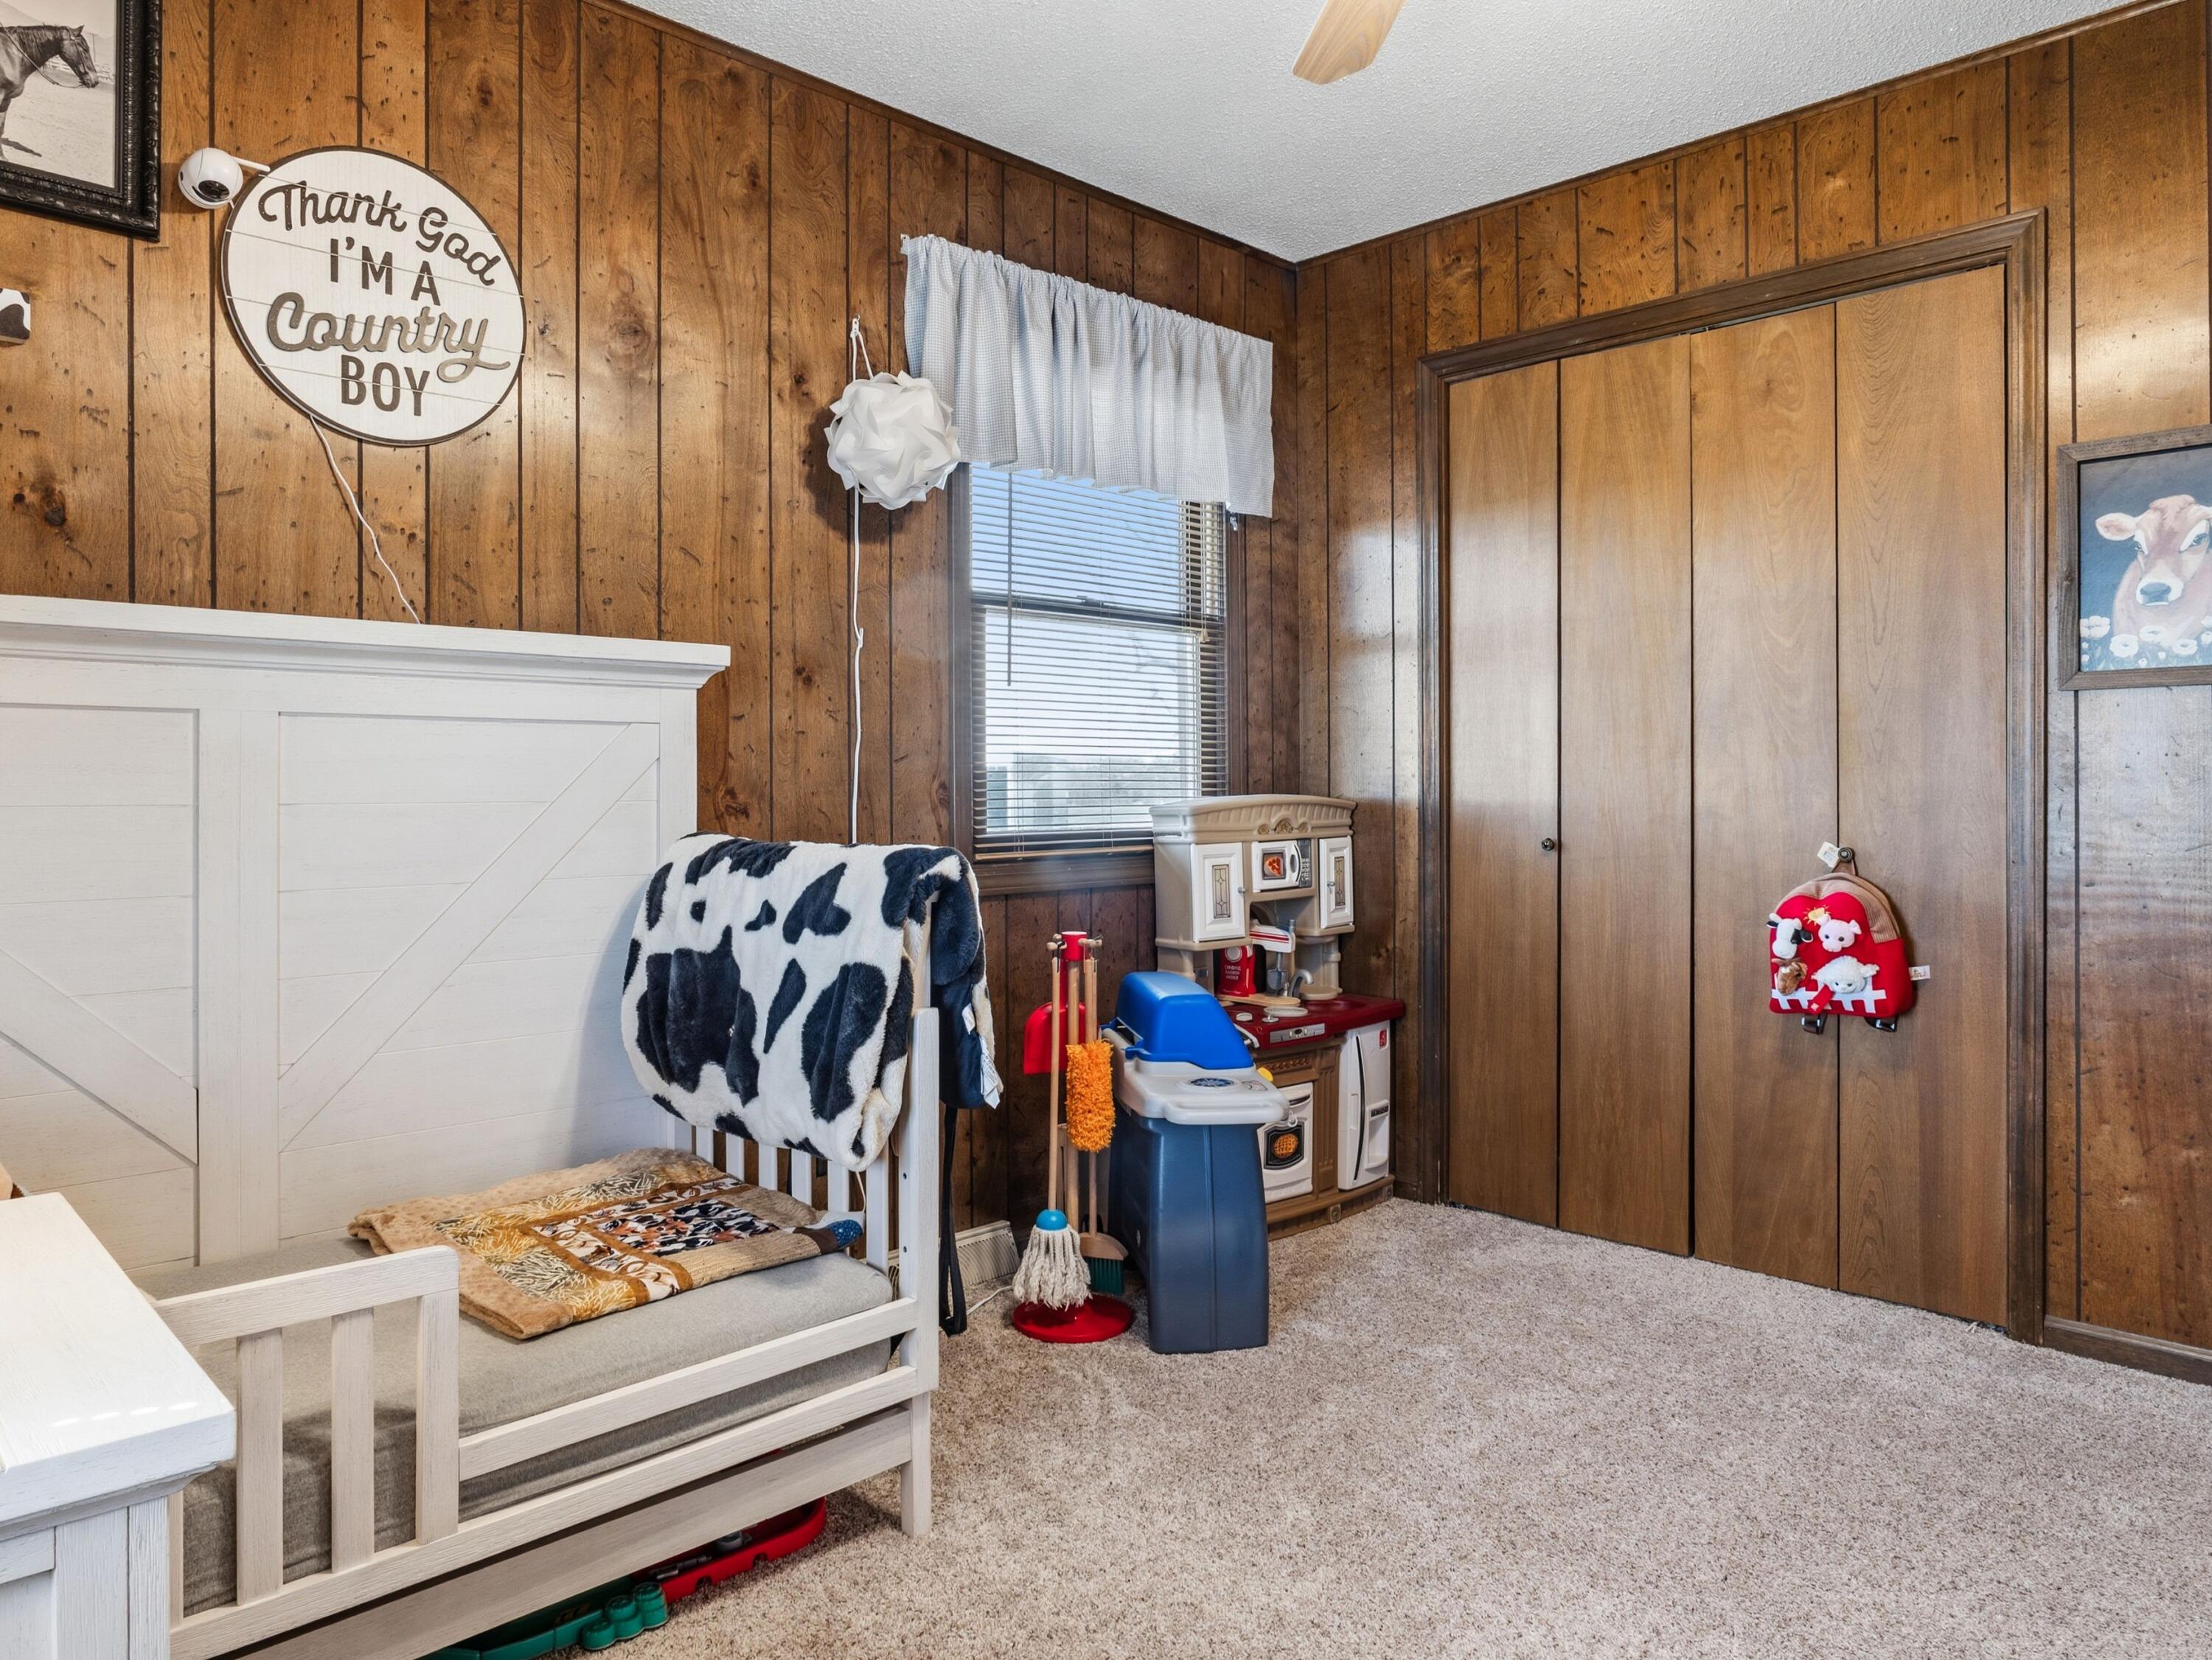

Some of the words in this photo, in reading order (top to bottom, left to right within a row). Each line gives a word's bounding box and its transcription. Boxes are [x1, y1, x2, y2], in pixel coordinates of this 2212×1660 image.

[258, 181, 407, 232] Thank
[416, 207, 501, 286] God
[330, 237, 393, 295] I'M
[411, 260, 441, 306] A
[267, 292, 510, 383] Country
[341, 355, 430, 416] BOY
